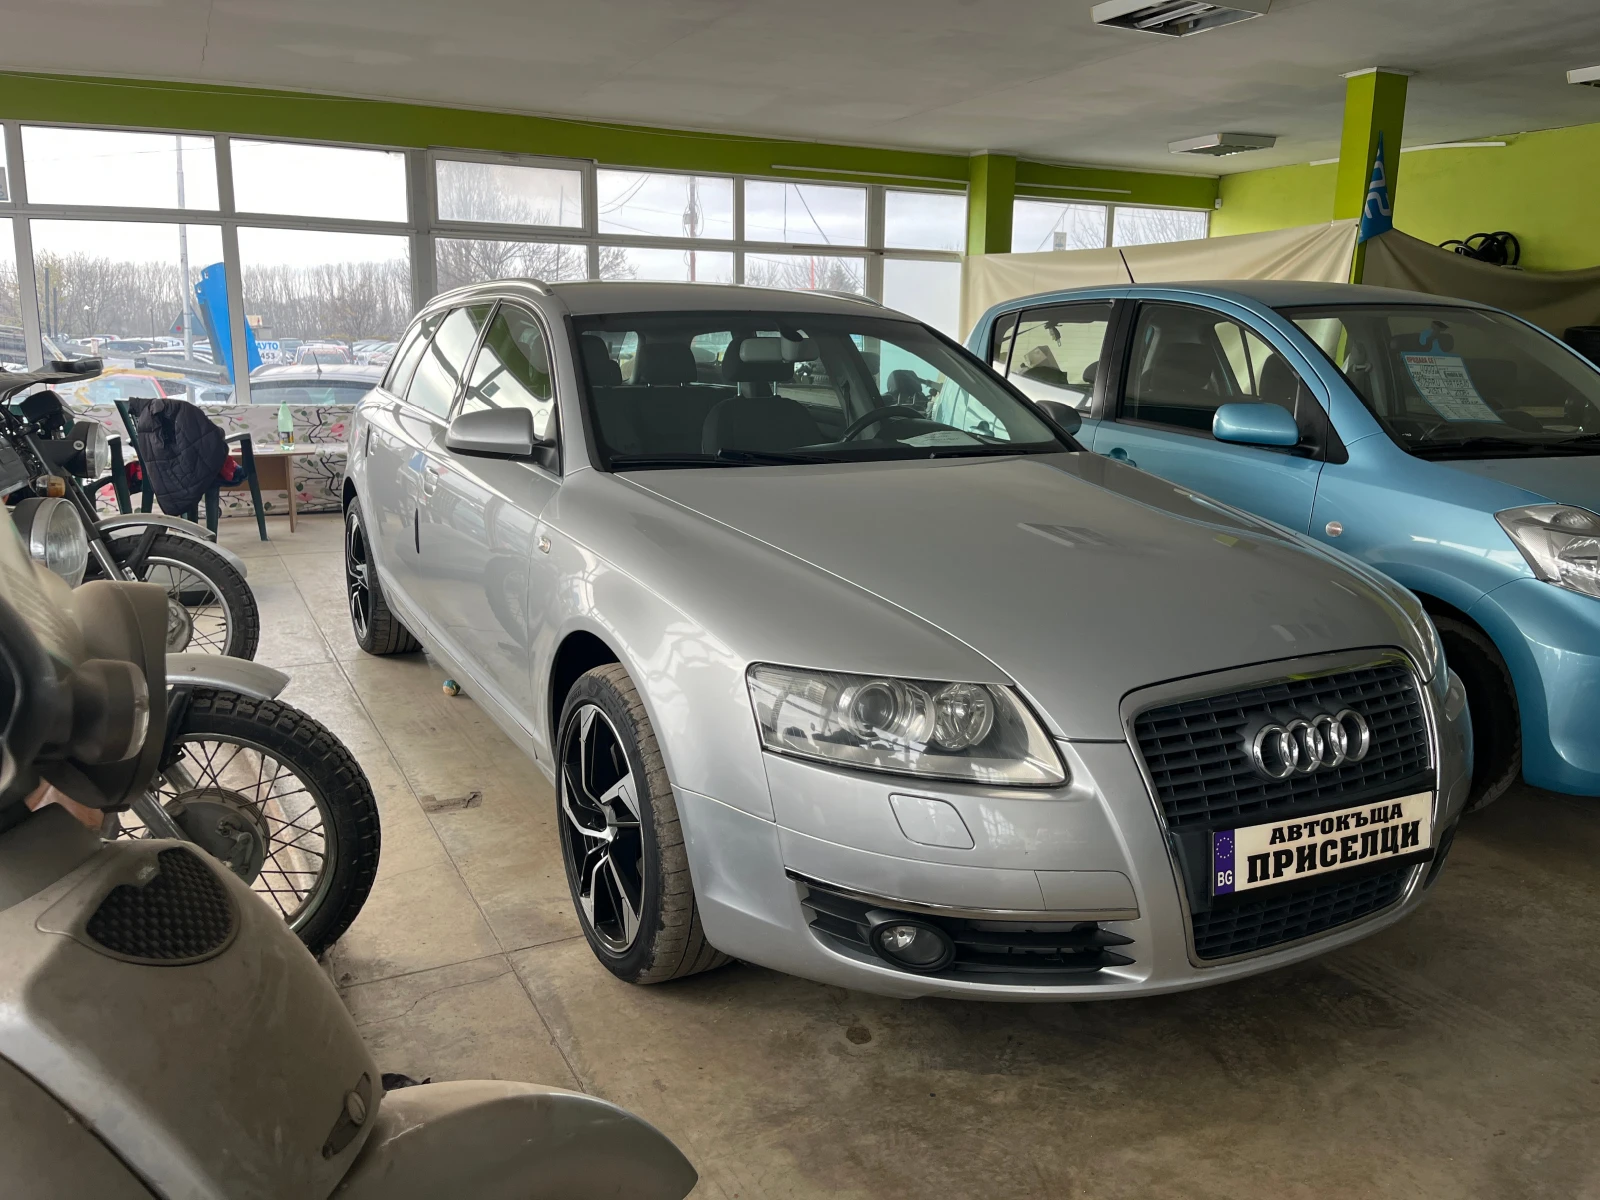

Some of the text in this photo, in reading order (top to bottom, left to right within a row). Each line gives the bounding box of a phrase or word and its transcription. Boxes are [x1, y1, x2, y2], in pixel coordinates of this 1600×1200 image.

[1269, 803, 1403, 845] АВТОКЪЩА
[1246, 820, 1421, 884] ПРИСЕЛЦИ
[1217, 869, 1233, 887] BG
